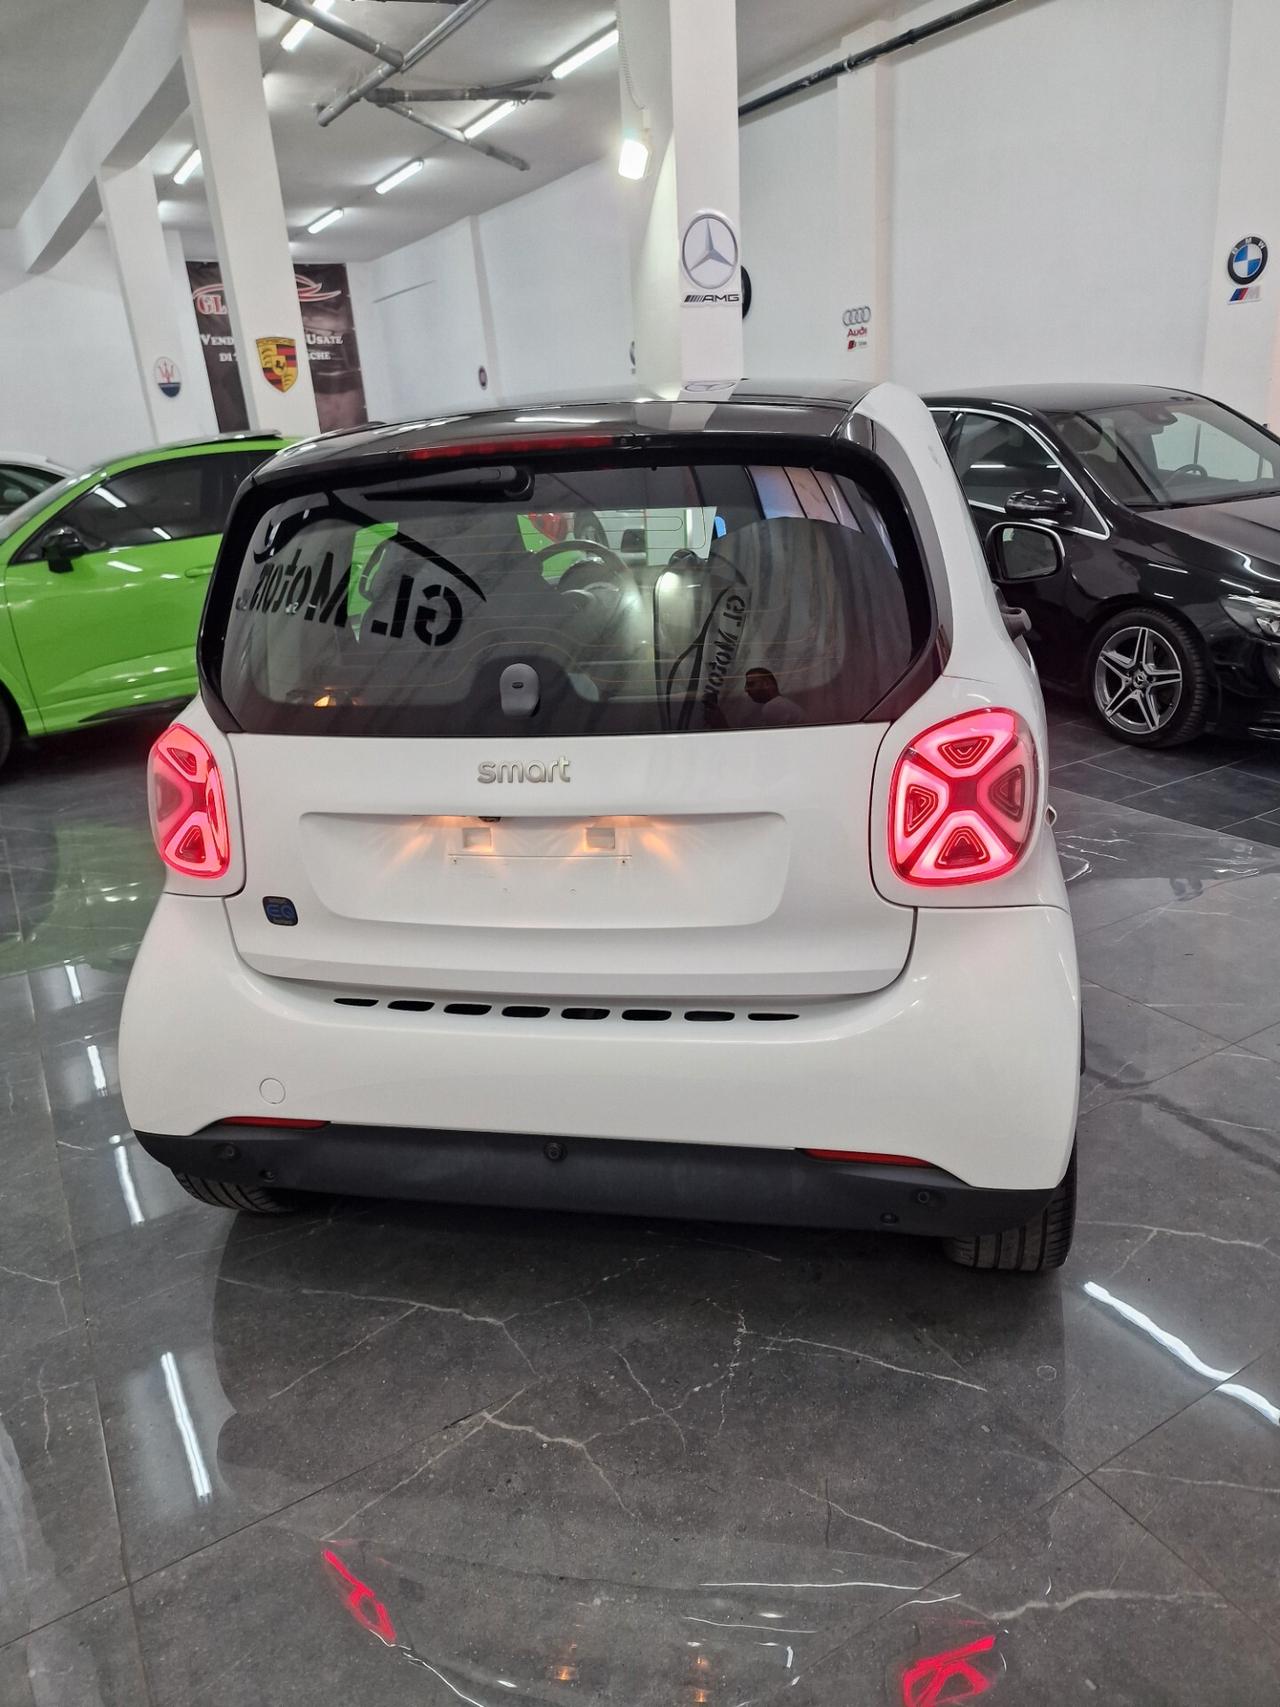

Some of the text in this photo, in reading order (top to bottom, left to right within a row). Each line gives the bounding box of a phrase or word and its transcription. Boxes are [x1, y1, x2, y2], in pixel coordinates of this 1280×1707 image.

[1231, 237, 1266, 255] BMW
[847, 326, 867, 337] Audi
[477, 756, 571, 784] smart
